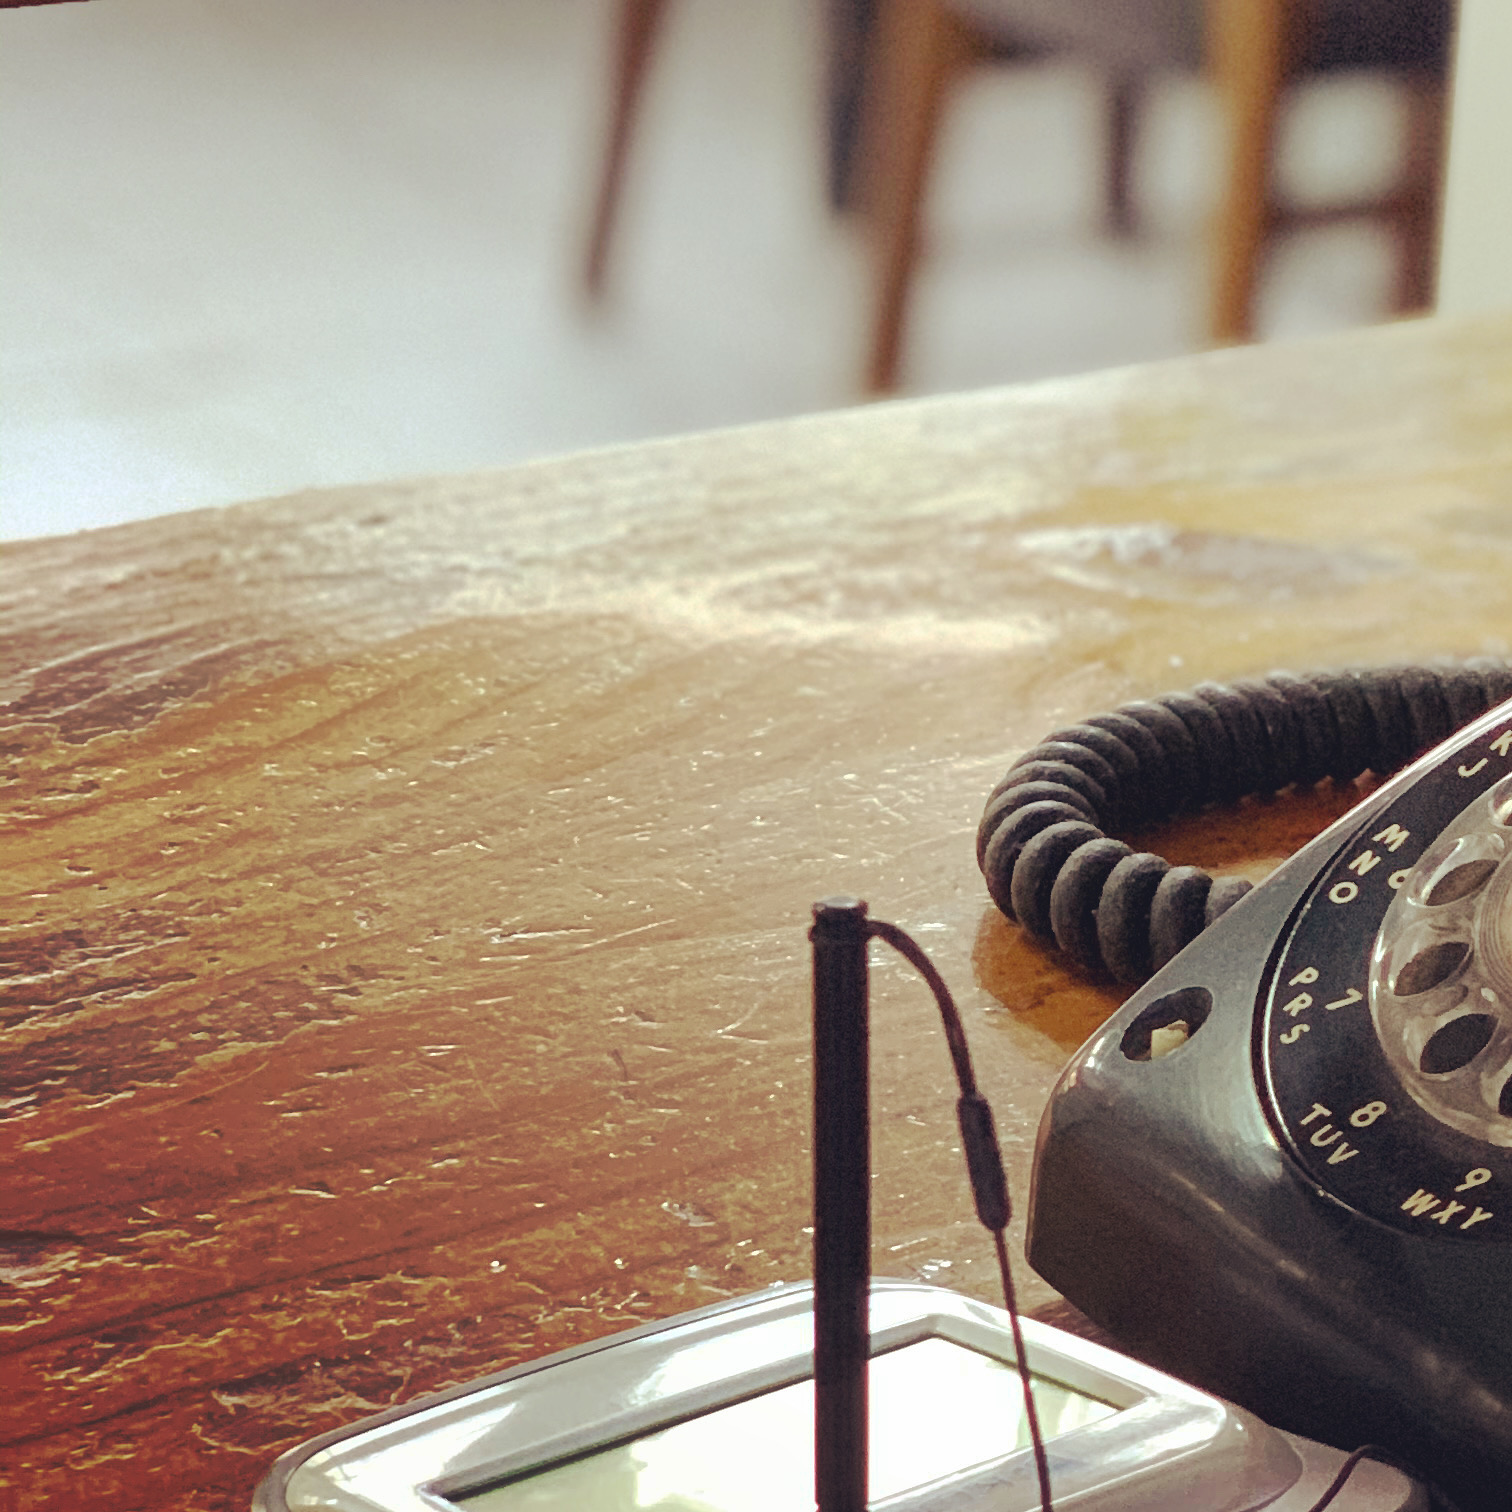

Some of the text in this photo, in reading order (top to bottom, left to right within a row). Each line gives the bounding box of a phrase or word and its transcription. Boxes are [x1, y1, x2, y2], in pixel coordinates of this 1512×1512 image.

[1279, 966, 1320, 1044] PRS
[1300, 1102, 1360, 1165] TUV
[1350, 1100, 1387, 1127] 8
[1454, 1167, 1492, 1192] 9
[1400, 1189, 1494, 1230] WXY
